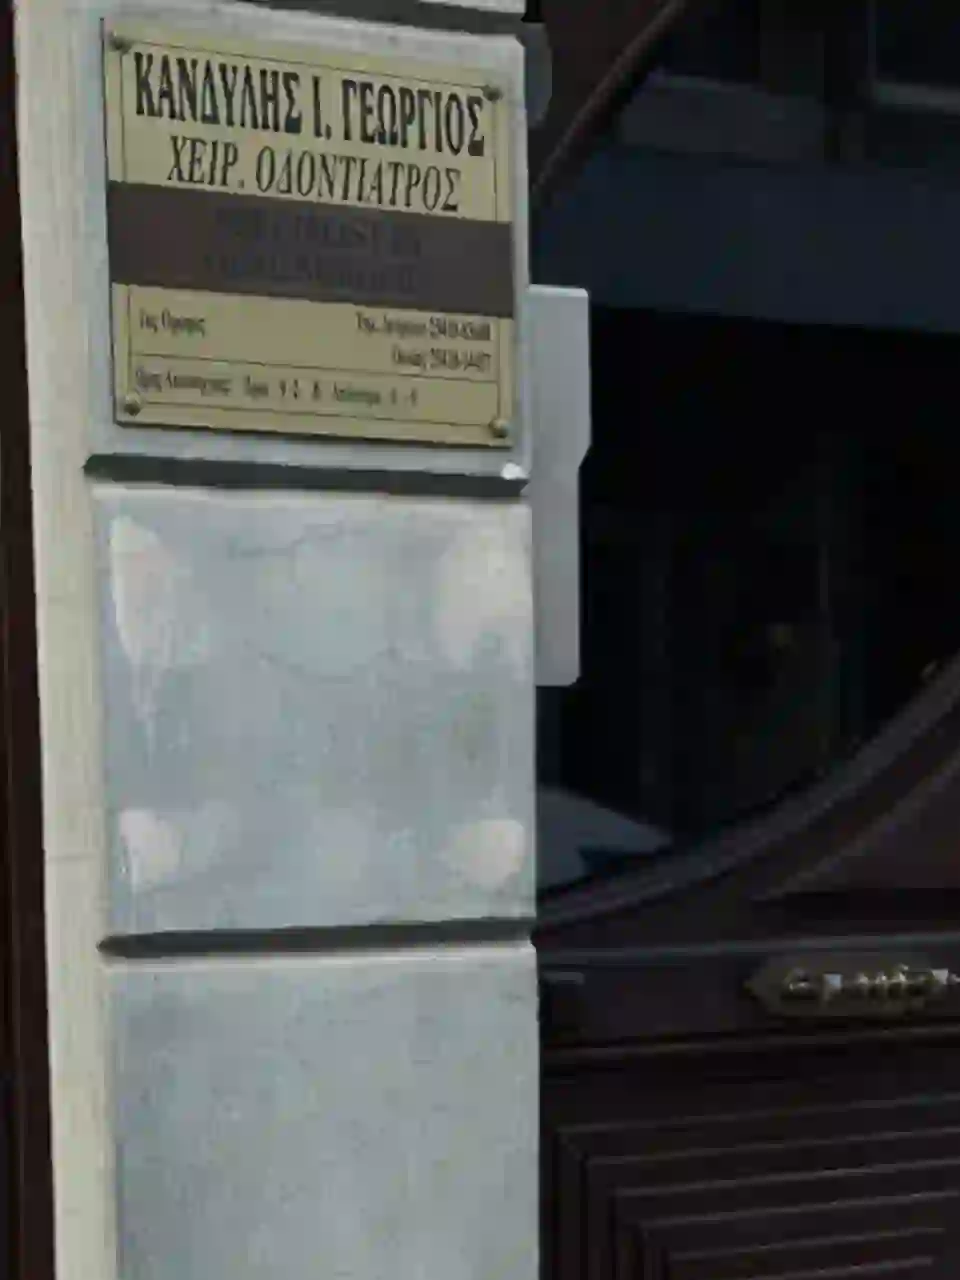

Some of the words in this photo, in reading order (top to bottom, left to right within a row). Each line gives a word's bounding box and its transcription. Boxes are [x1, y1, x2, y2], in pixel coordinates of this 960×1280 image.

[134, 51, 303, 134] ΚΑΝΔΥΛΗΣ
[341, 79, 485, 157] ΓΕΩΡΓΙΟΣ
[255, 145, 462, 212] ΟΔΟΝΤΙΑΤΡΟΣ
